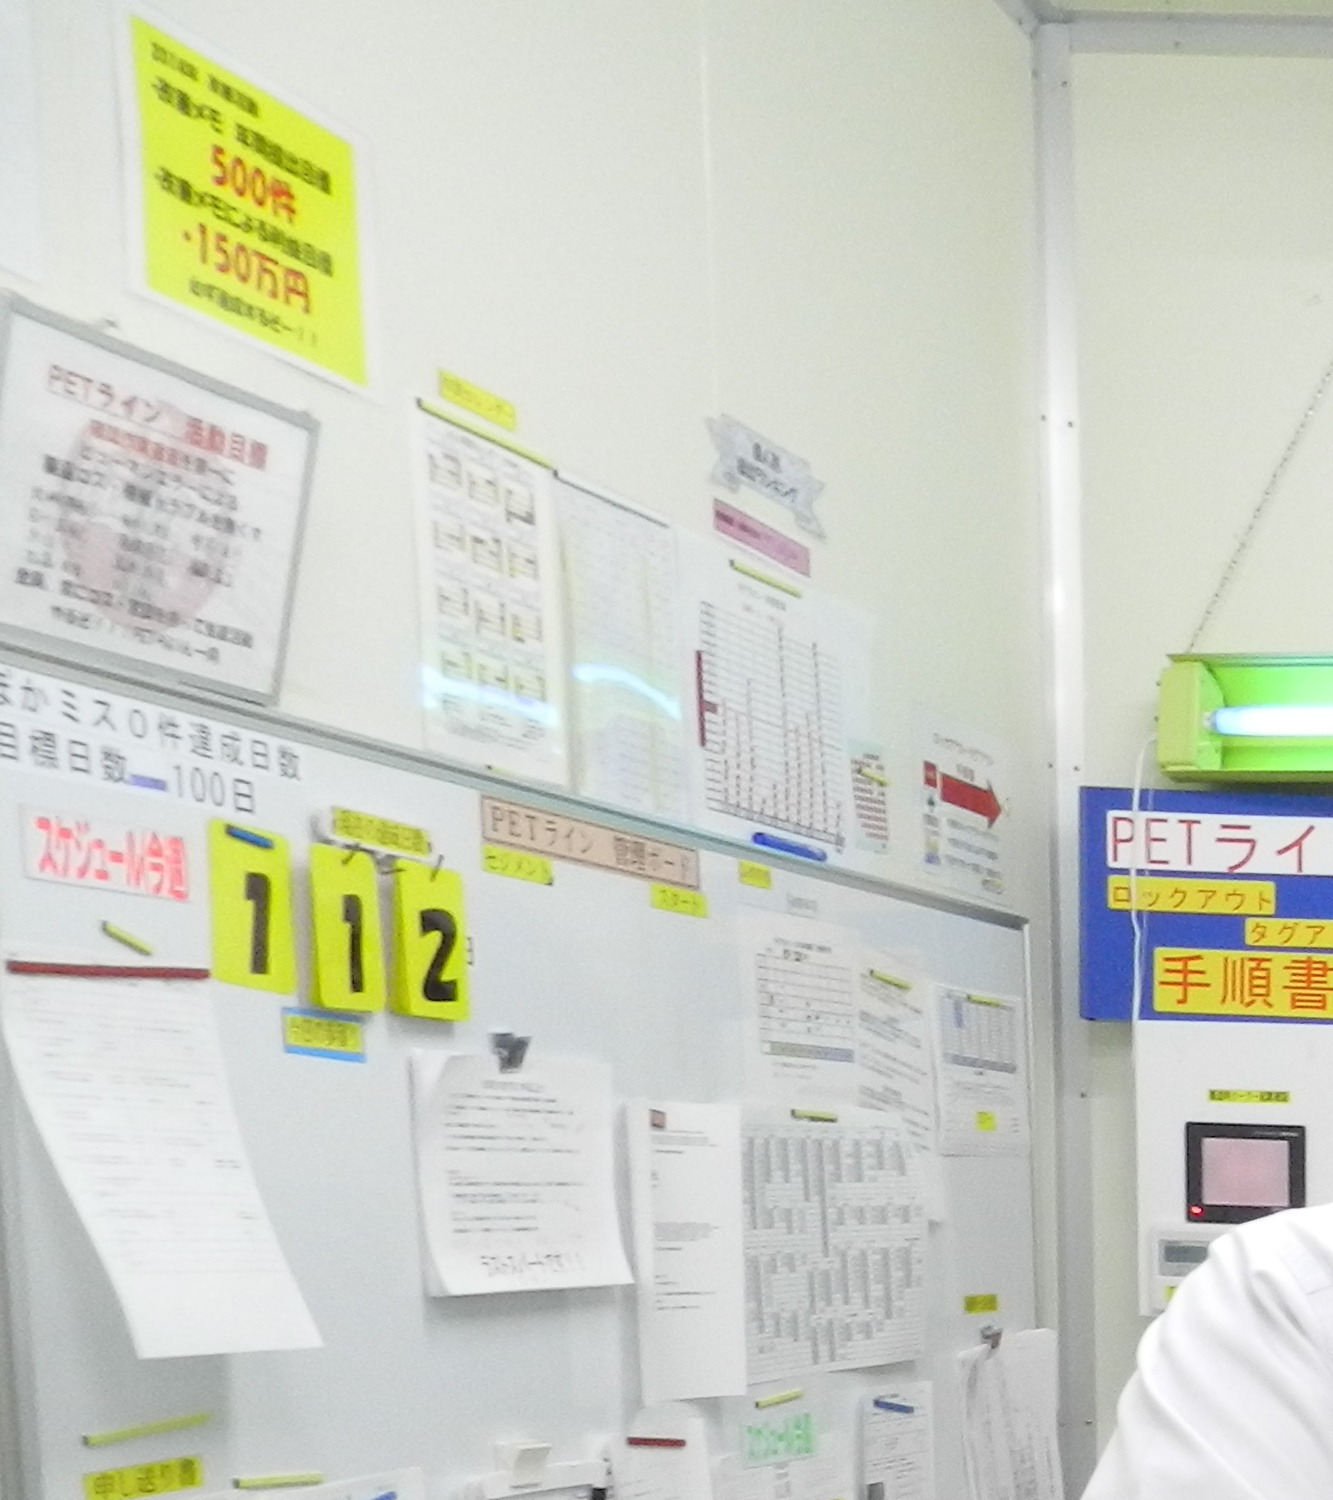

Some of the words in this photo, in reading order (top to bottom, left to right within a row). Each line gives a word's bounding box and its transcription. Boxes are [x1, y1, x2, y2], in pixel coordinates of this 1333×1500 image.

[211, 144, 296, 224] 500件
[1112, 886, 1273, 912] ロックアウト
